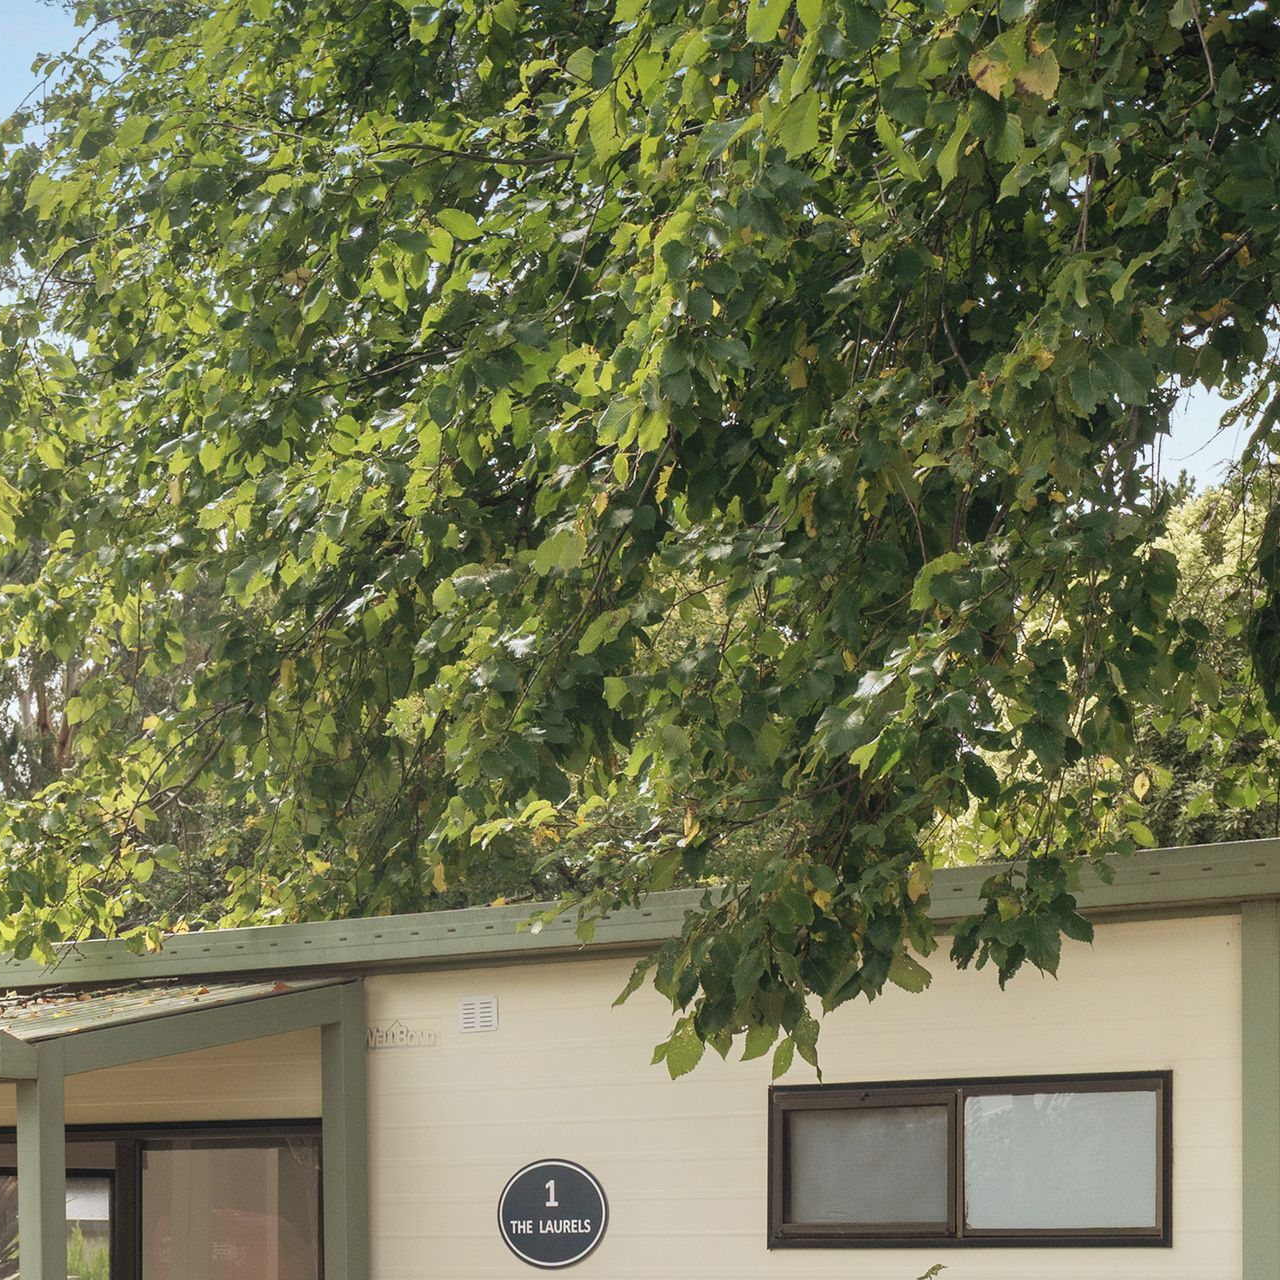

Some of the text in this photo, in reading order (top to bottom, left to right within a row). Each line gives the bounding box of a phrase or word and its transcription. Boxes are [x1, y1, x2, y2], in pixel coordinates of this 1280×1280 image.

[545, 1180, 559, 1207] 1
[510, 1219, 591, 1234] THE LAURELS
